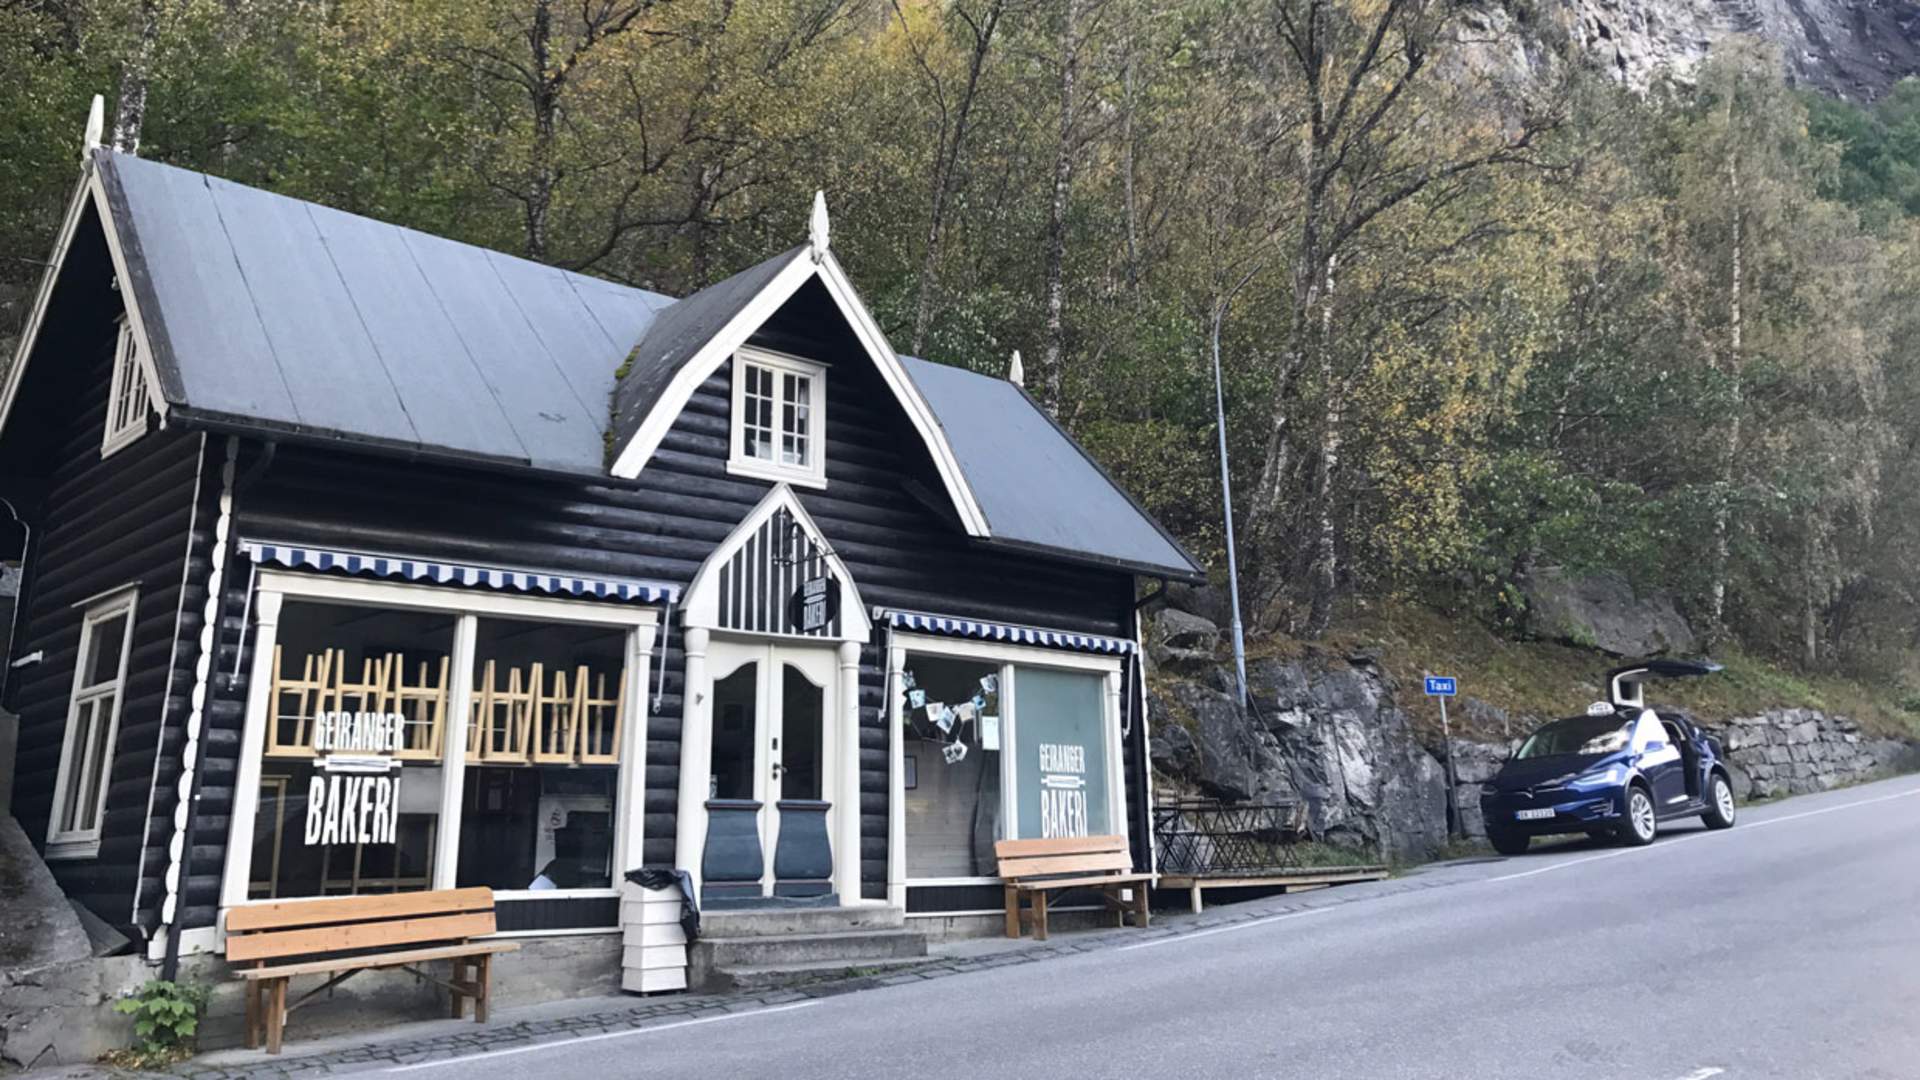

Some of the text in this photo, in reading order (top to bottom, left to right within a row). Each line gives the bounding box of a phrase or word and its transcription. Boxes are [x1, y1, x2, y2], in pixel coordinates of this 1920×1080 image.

[1429, 679, 1452, 691] Taxi
[315, 711, 405, 750] GEIRANGER
[1039, 743, 1086, 774] GEIRANGER
[304, 775, 401, 846] BAKERI
[1041, 789, 1088, 839] BAKERI
